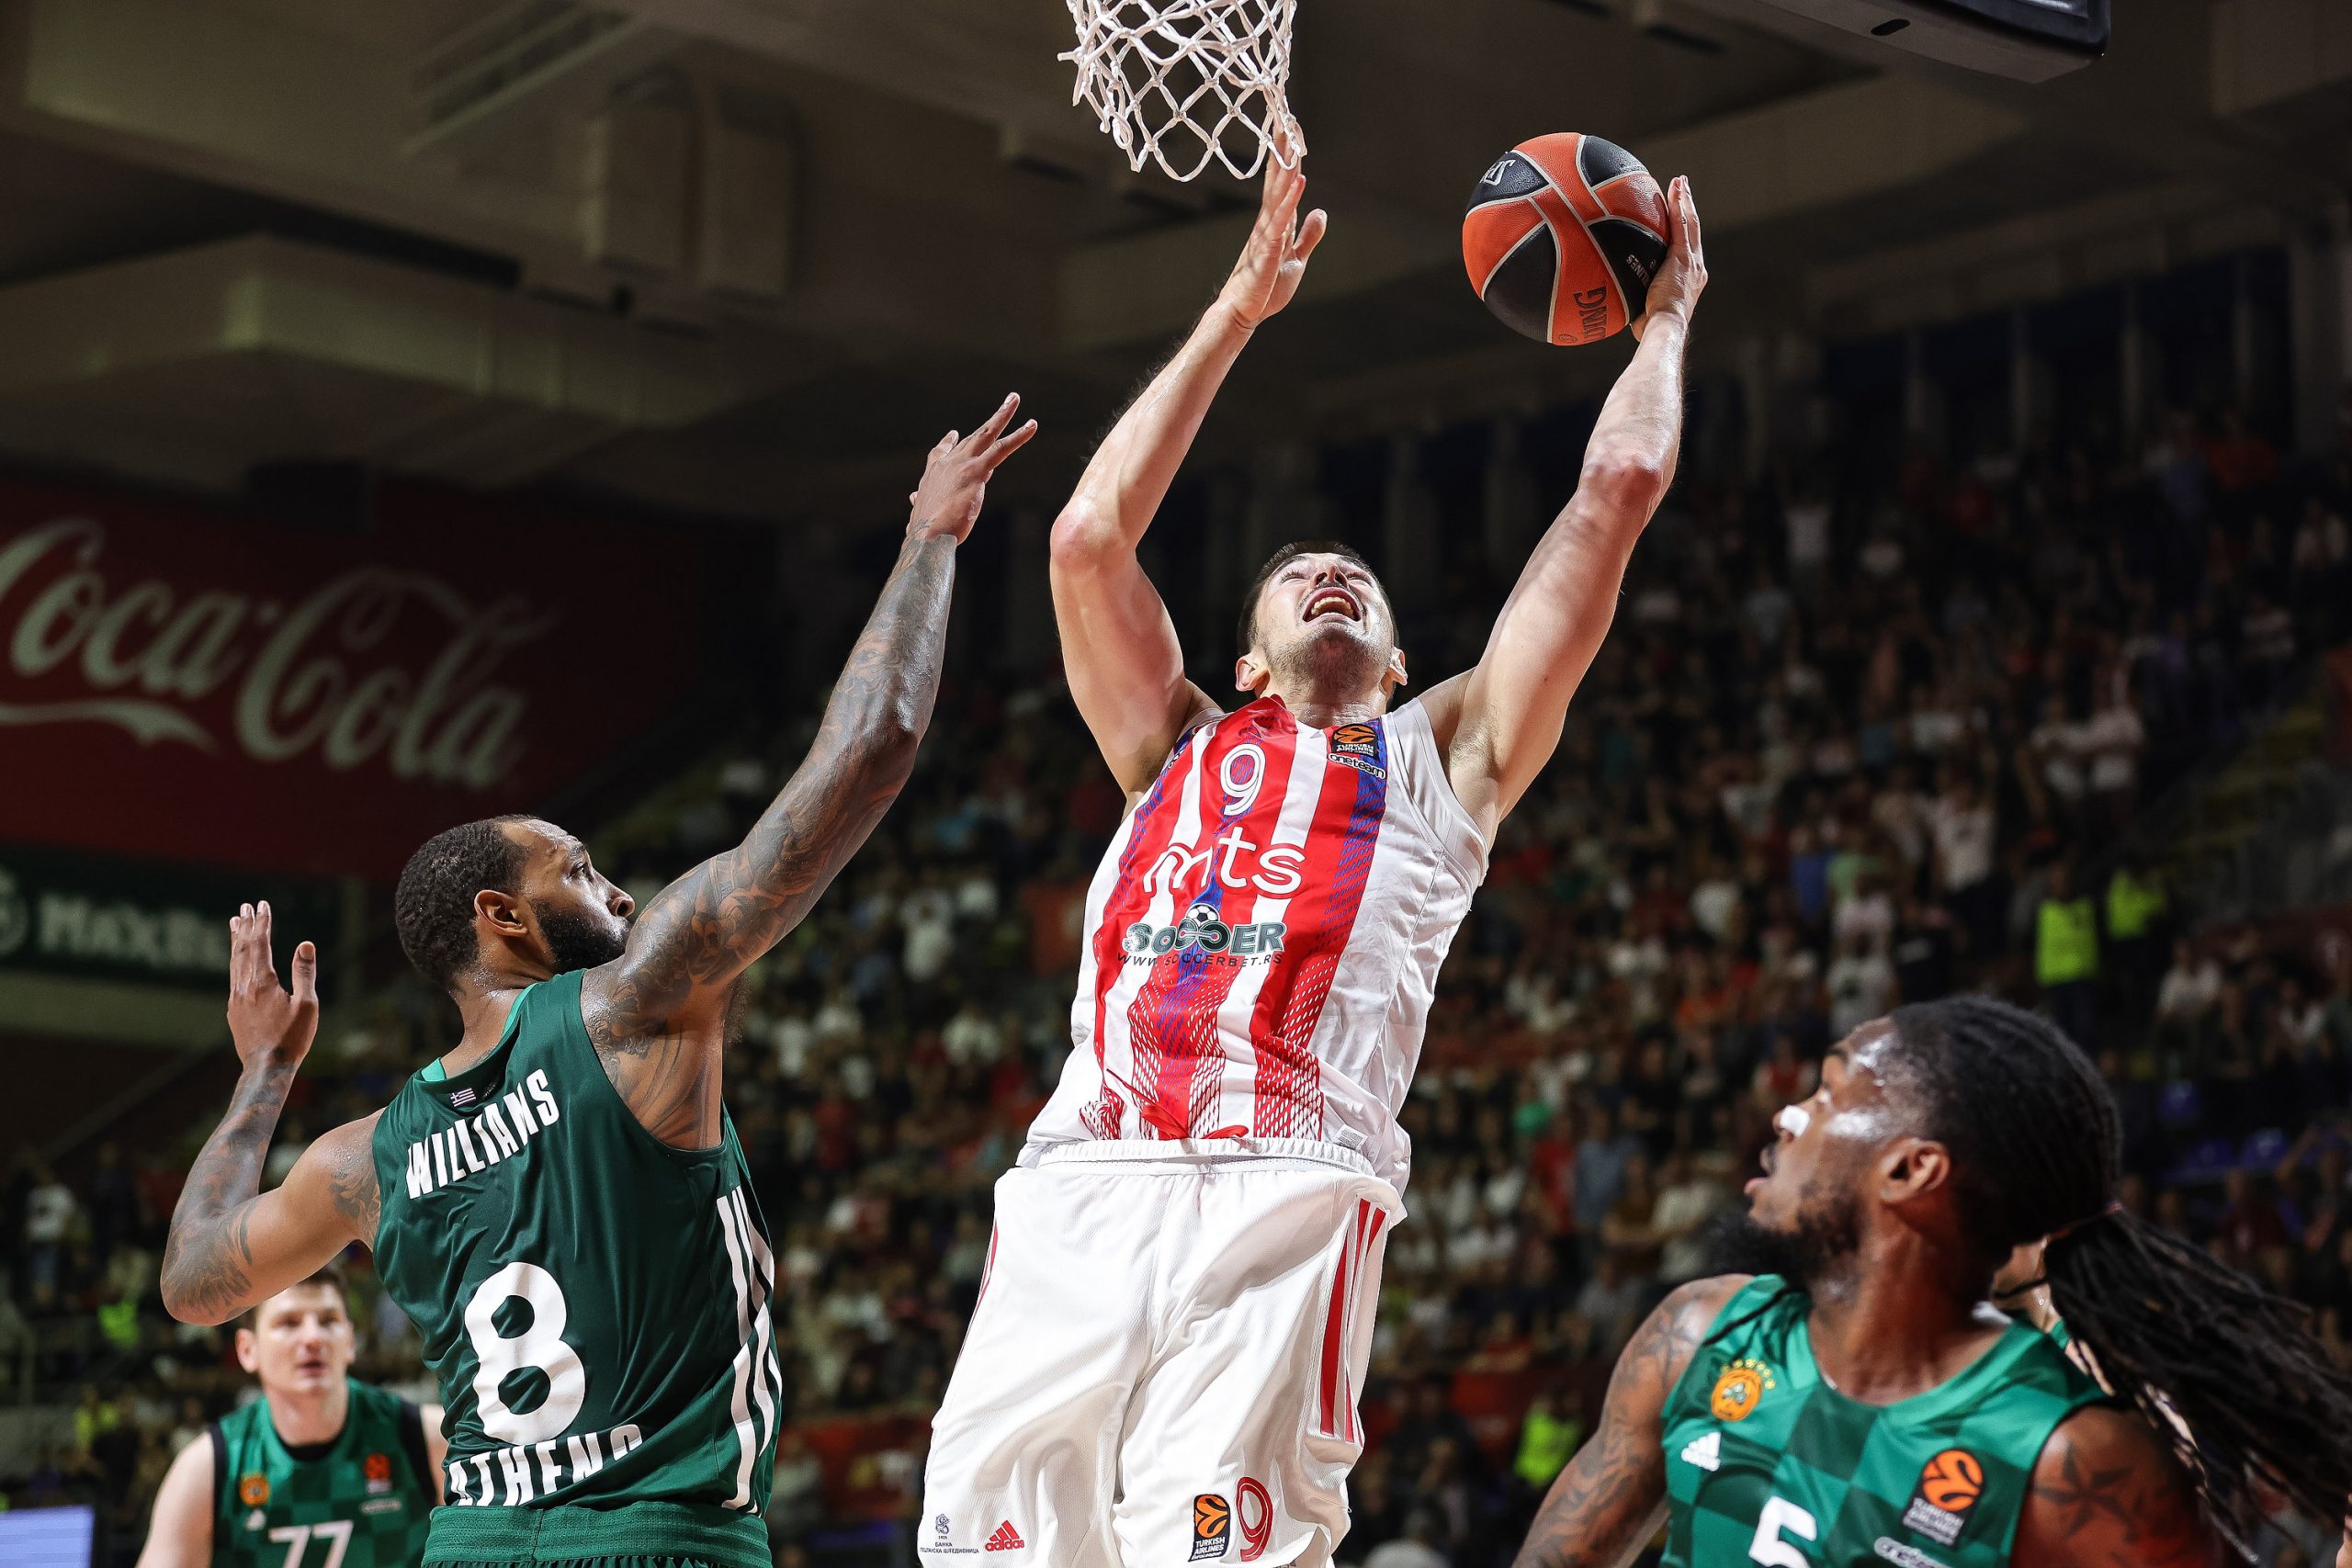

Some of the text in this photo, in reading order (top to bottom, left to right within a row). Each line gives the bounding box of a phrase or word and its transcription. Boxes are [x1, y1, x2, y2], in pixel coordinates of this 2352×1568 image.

[1573, 286, 1608, 338] DING
[1219, 743, 1267, 817] 9
[1142, 826, 1306, 897] mts
[464, 1261, 585, 1446] 8
[268, 1519, 354, 1568] 77
[985, 1539, 1025, 1552] adidas
[1193, 1544, 1225, 1555] AIRLINES
[1195, 1536, 1226, 1548] TURKISH
[1236, 1476, 1274, 1562] 9
[1748, 1495, 1818, 1568] 5
